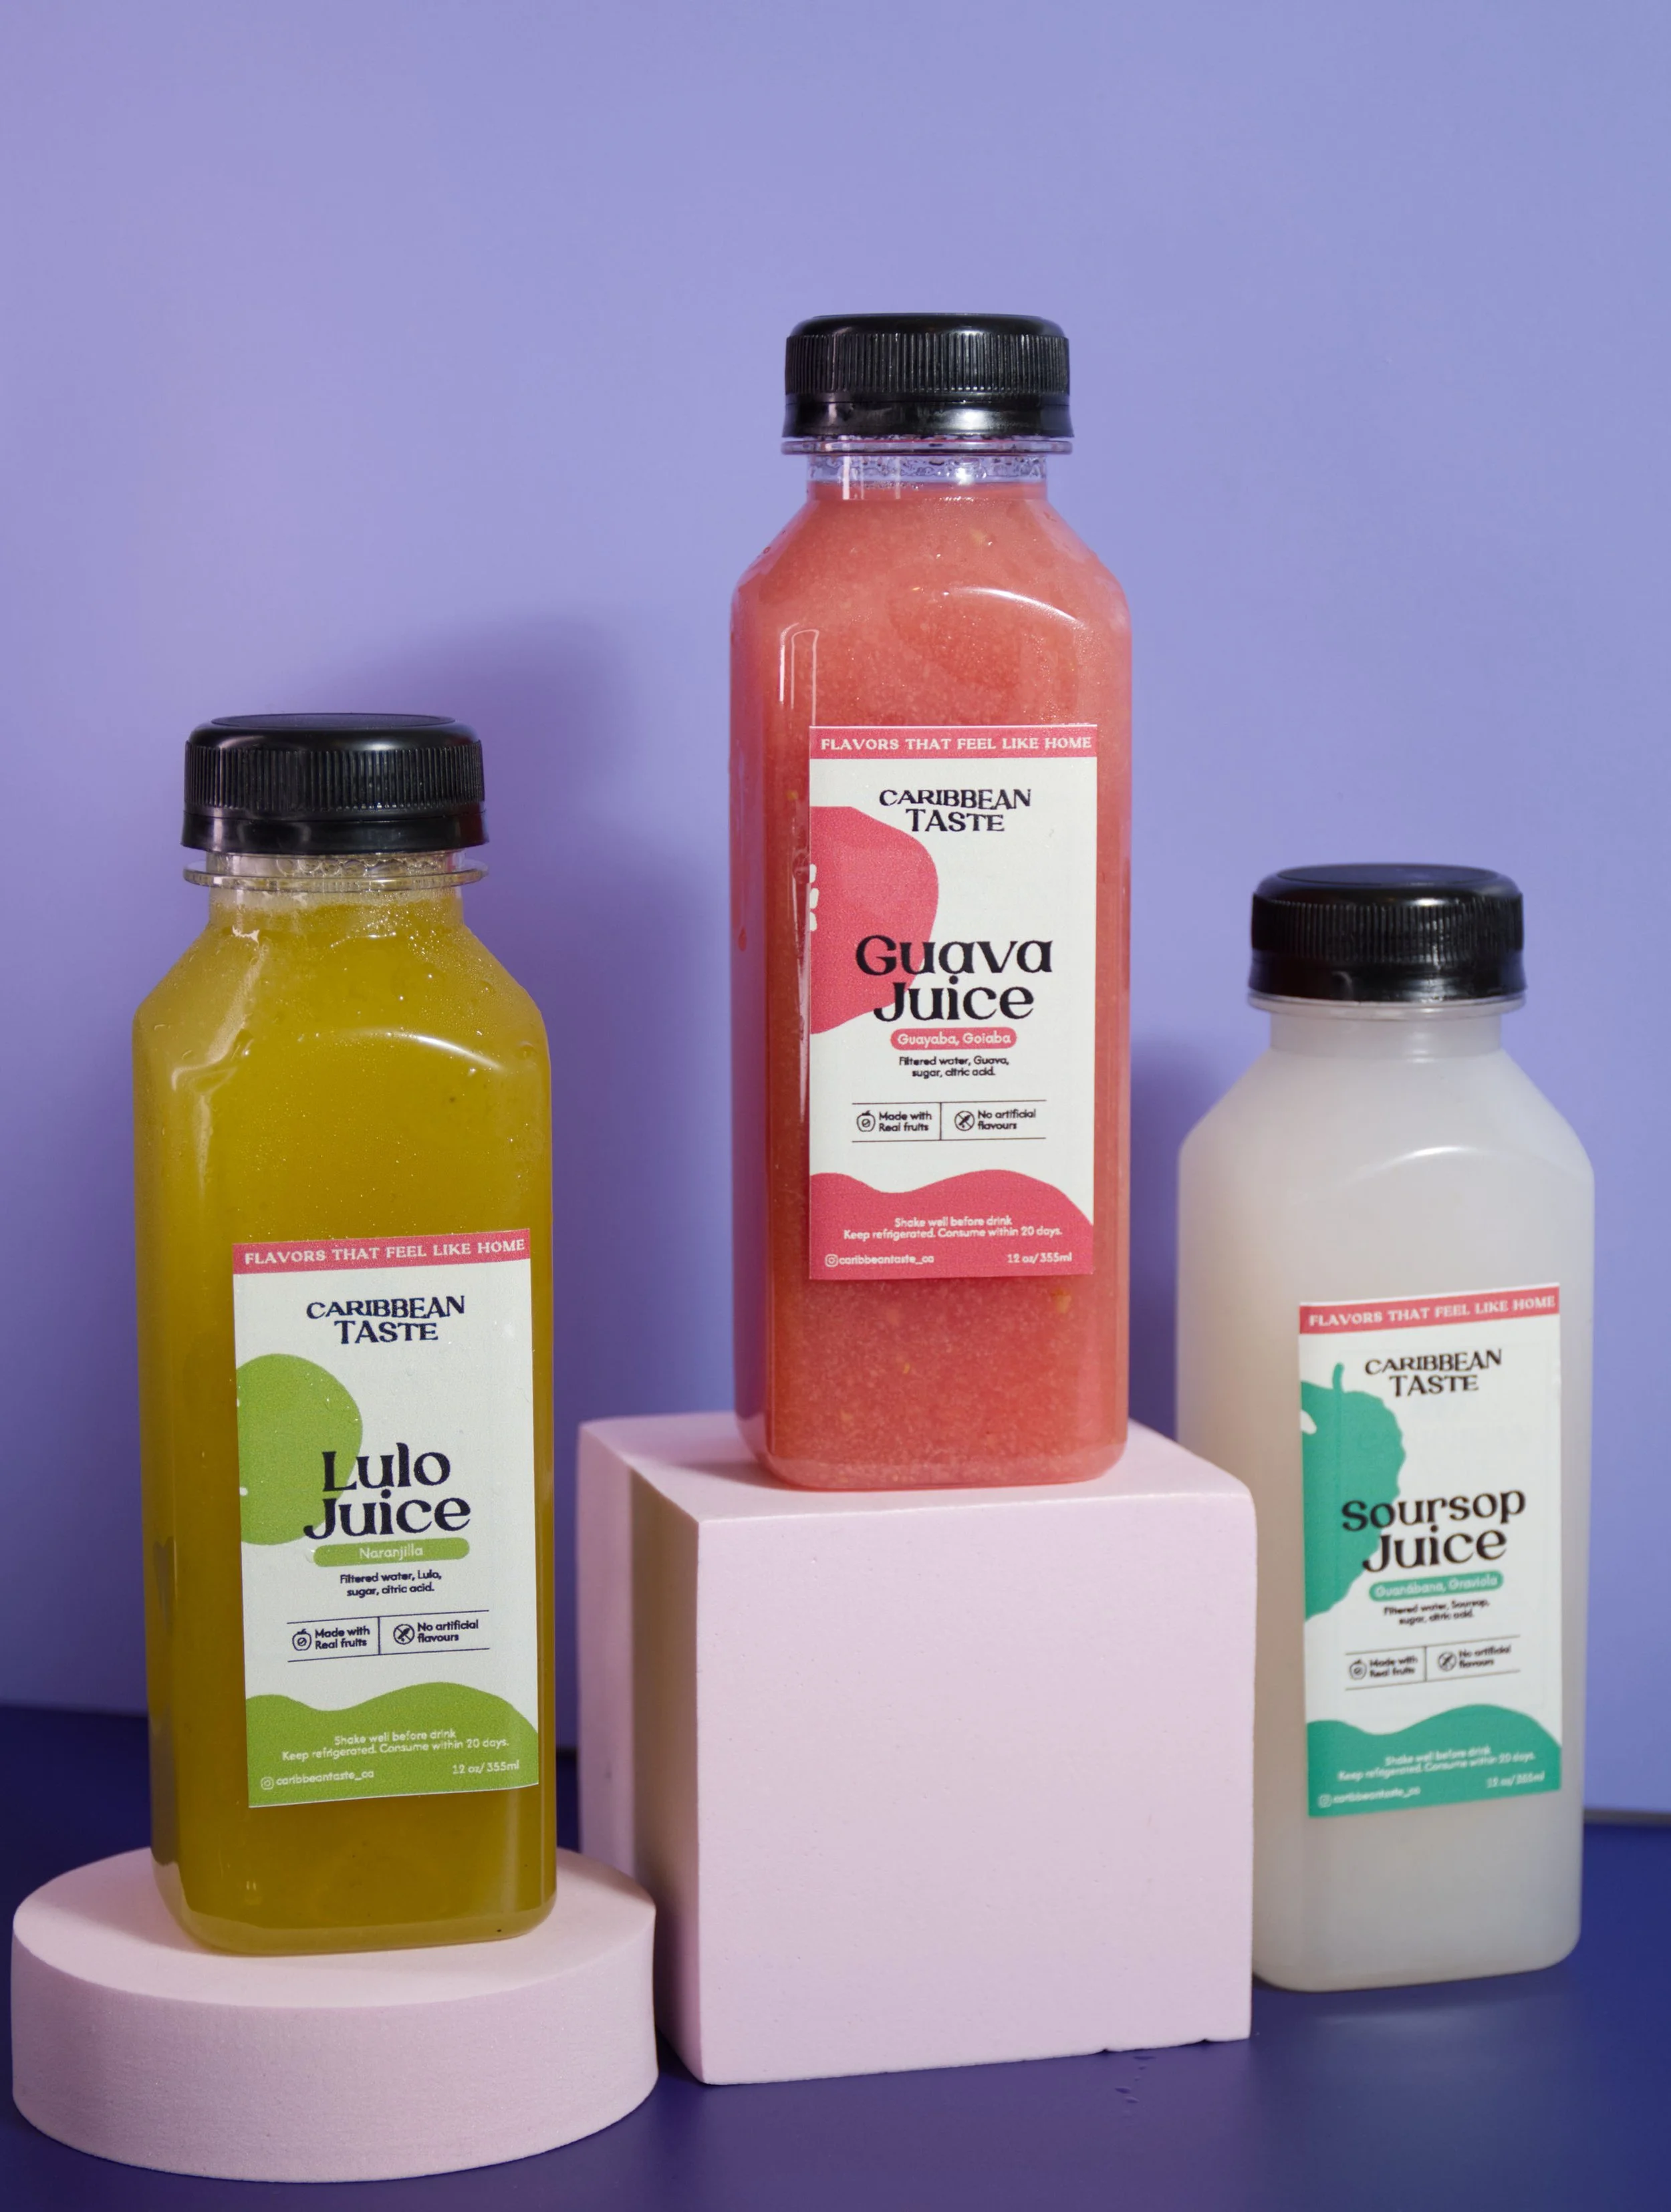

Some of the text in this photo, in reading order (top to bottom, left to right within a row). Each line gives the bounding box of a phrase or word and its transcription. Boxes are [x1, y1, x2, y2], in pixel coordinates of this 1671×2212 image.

[821, 737, 1091, 750] FLAVORS THAT FEEL LIKE HOME
[880, 789, 1031, 810] CARIBBEAN
[906, 809, 1005, 831] TASTE
[856, 935, 1053, 976] Guava
[873, 975, 1035, 1022] Juice
[897, 1032, 1011, 1047] Guayaba, Goiaba
[899, 1057, 1009, 1067] Filtered water, Guava,
[912, 1067, 995, 1079] sugar, citric acid.
[879, 1111, 932, 1120] Made with
[978, 1109, 1036, 1119] No artificial
[879, 1122, 928, 1131] Real fruits
[978, 1121, 1017, 1130] flavours
[894, 1216, 1013, 1228] Shake well before drink
[844, 1226, 1062, 1242] Keep refrigerated. Consume within 20 days.
[245, 1239, 525, 1265] FLAVORS THAT FEEL LIKE HOME
[1007, 1254, 1020, 1263] 12
[1041, 1252, 1072, 1262] 355ml
[307, 1295, 465, 1320] CARIBBEAN
[1309, 1296, 1555, 1327] FLAVORS THAT FEEL LIKE HOME
[334, 1320, 438, 1344] TASTE
[1365, 1349, 1503, 1375] CARIBBEAN
[1389, 1375, 1479, 1397] TASTE
[322, 1442, 451, 1492] Lulo
[303, 1489, 471, 1540] Juice
[1341, 1489, 1526, 1531] Soursop
[359, 1546, 423, 1562] Naranjilla
[1362, 1524, 1507, 1572] Juice
[340, 1570, 442, 1584] Filtered water, Lulo,
[1448, 1574, 1498, 1589] Graviola
[347, 1583, 434, 1599] sugar, citric acid.
[315, 1626, 370, 1639] Made with
[417, 1619, 479, 1631] No artificial
[315, 1638, 367, 1650] Real fruits
[417, 1633, 459, 1643] flavours
[335, 1729, 455, 1746] Shake well before drink
[282, 1738, 509, 1762] Keep refrigerated. Consume within 20 days.
[453, 1764, 466, 1774] 12
[487, 1760, 519, 1772] 355ml
